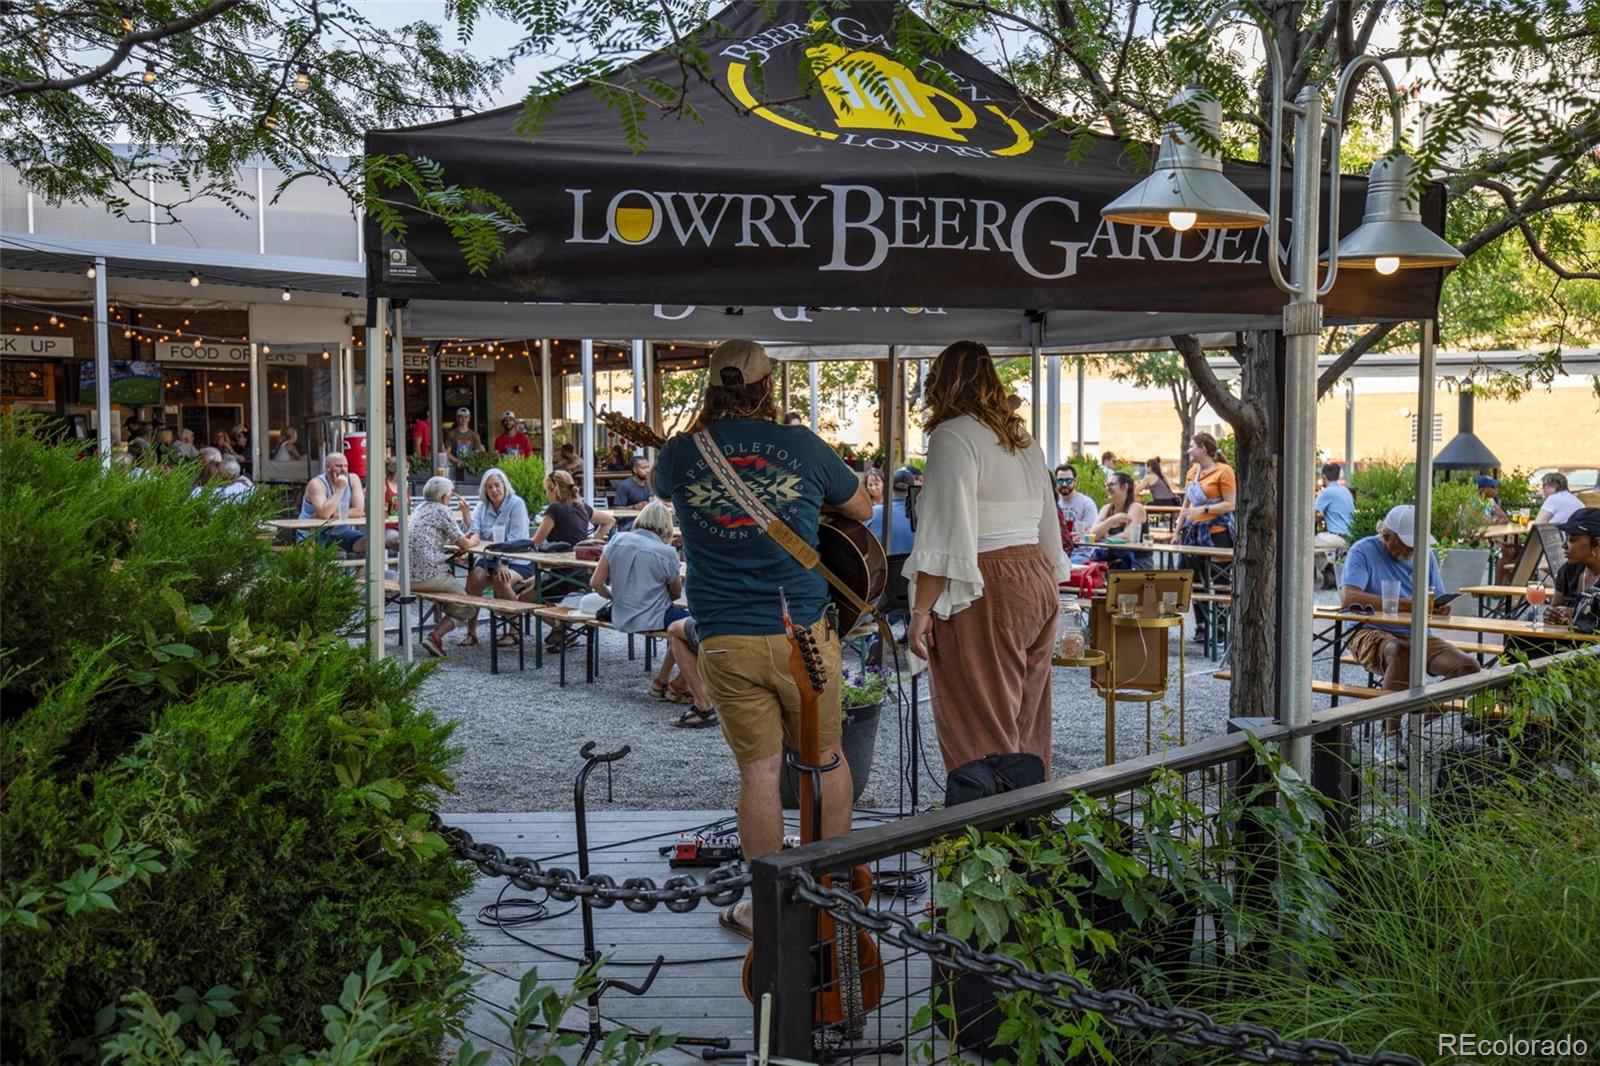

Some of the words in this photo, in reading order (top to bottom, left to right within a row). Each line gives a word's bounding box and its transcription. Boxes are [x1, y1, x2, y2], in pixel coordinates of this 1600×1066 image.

[719, 23, 811, 67] BEER
[838, 132, 998, 159] LOWRY
[564, 188, 828, 248] LOWRY
[818, 183, 1013, 272] BEER
[31, 340, 56, 353] UP
[170, 345, 219, 360] FOOD
[229, 347, 297, 362] ORERS
[403, 355, 429, 367] EER
[686, 441, 802, 480] PEDLETON
